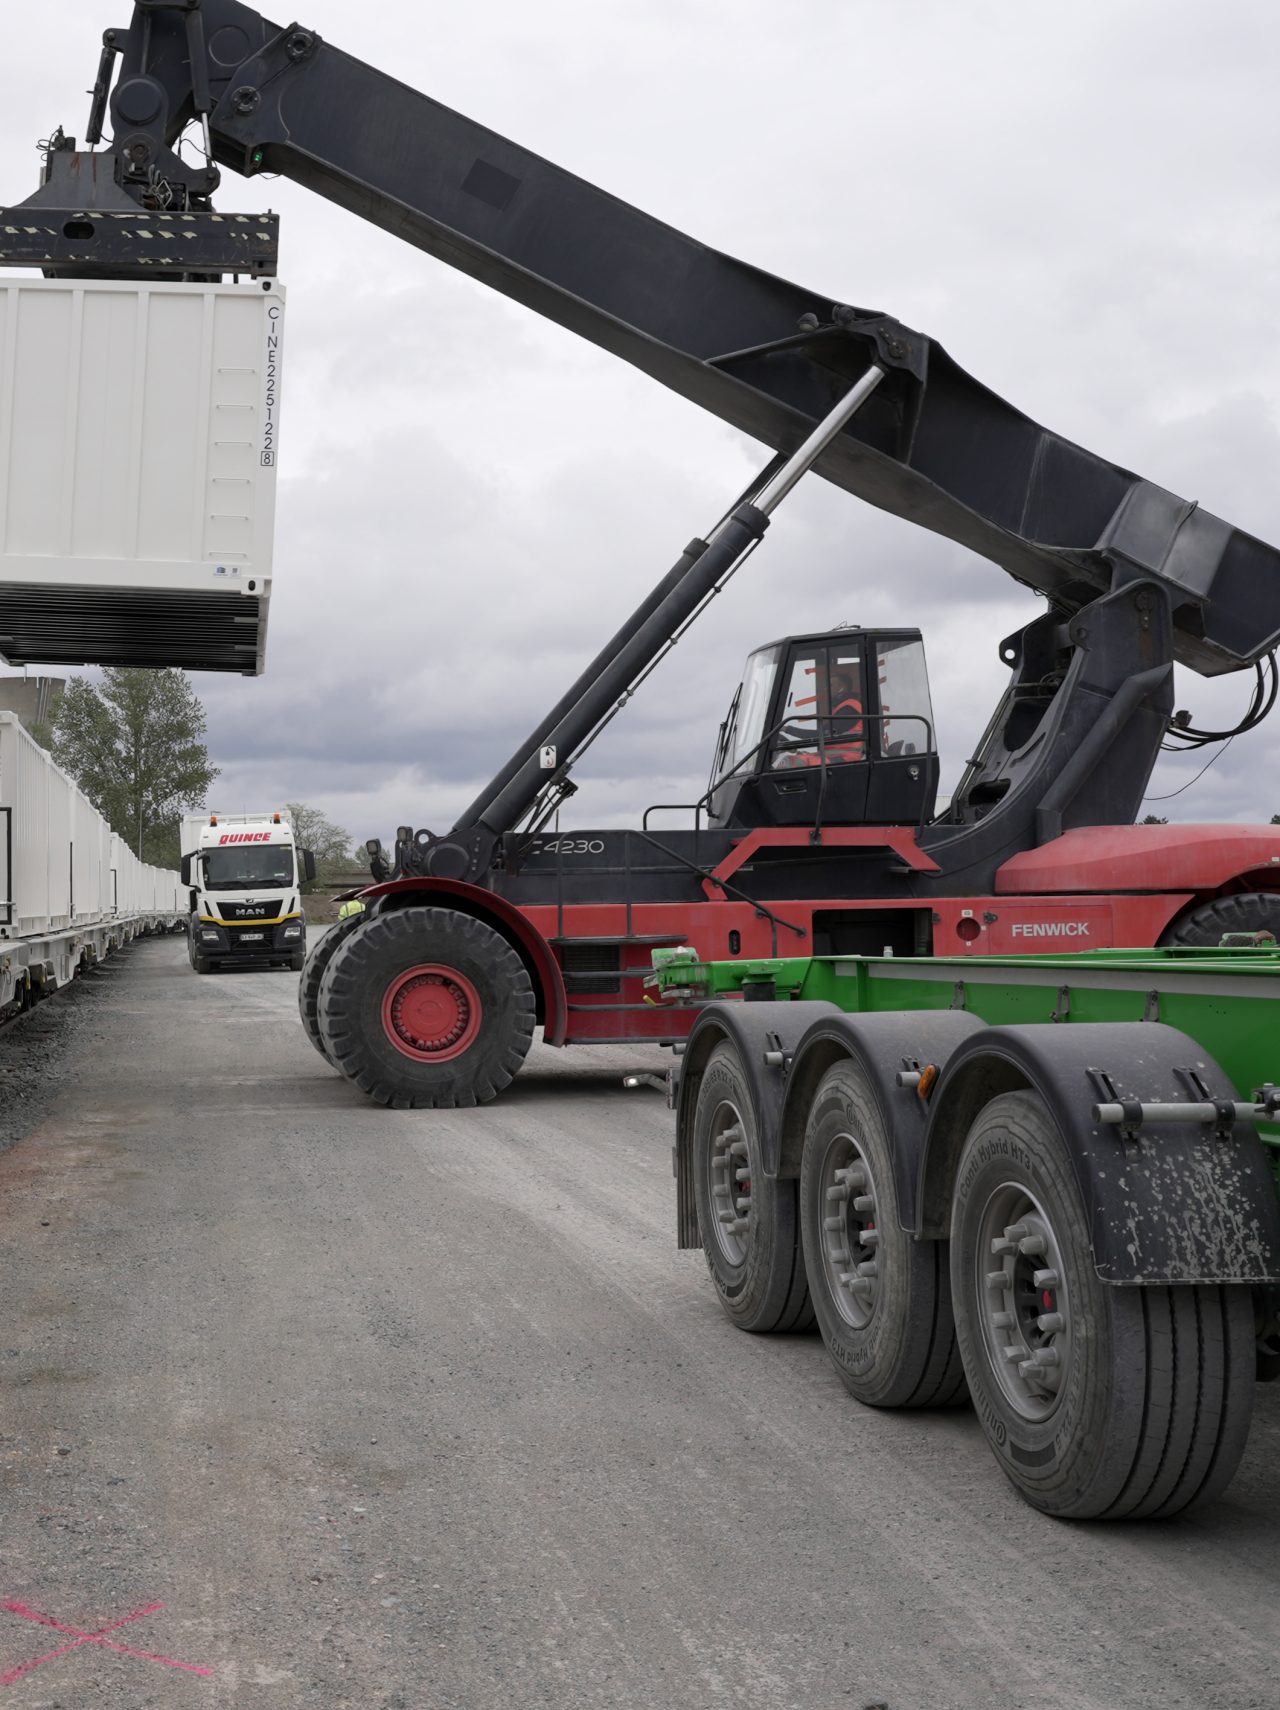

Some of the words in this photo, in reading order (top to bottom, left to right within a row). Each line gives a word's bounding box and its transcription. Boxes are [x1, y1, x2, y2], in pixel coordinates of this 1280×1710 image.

[218, 832, 272, 846] QUINCE
[235, 908, 265, 916] MAN
[1011, 922, 1089, 937] FENWICK
[960, 1153, 980, 1198] Conti
[977, 1138, 1009, 1163] Hybrid
[1010, 1140, 1031, 1170] HT3
